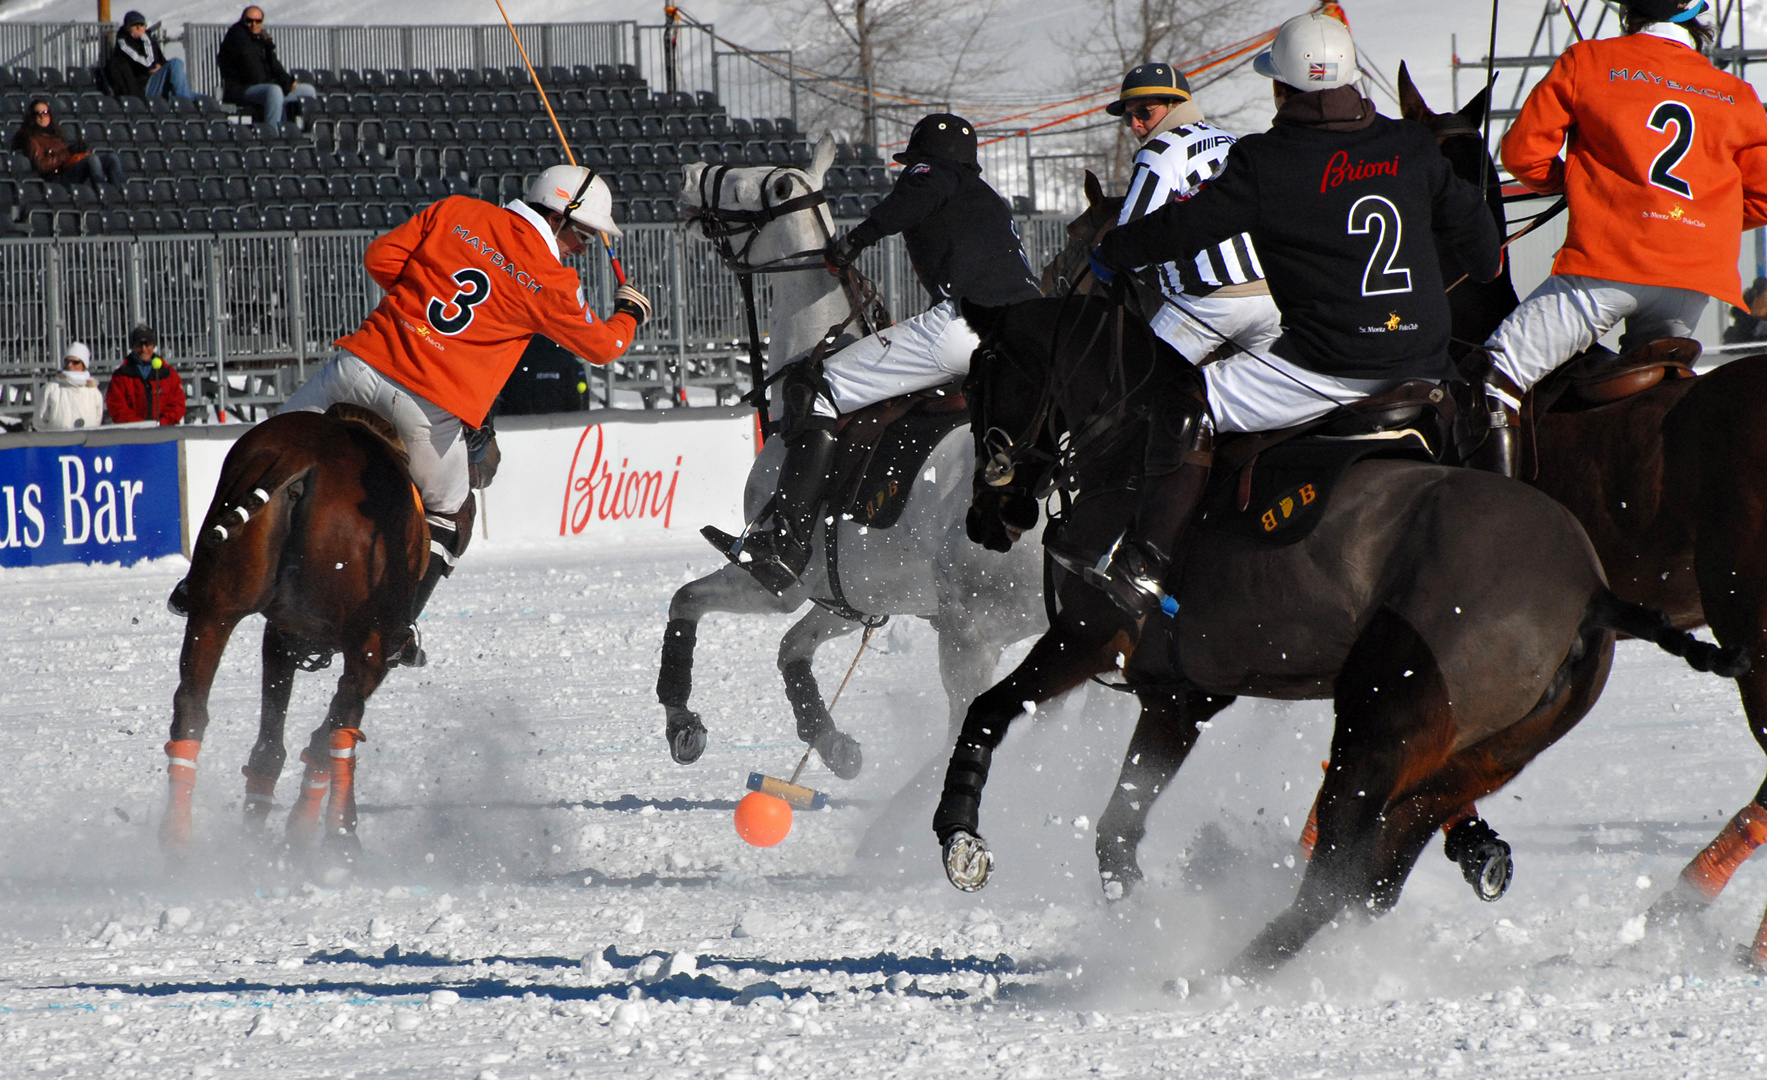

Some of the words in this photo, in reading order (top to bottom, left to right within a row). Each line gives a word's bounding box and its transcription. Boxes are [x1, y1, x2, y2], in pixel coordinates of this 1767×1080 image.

[1609, 68, 1735, 105] MAYBACH
[1320, 150, 1400, 193] Brioni
[1646, 100, 1695, 200] 2
[452, 224, 543, 295] MAYBACH
[1347, 195, 1413, 296] 2
[426, 267, 491, 336] 3
[58, 455, 144, 546] Bär
[560, 423, 682, 536] Brioni
